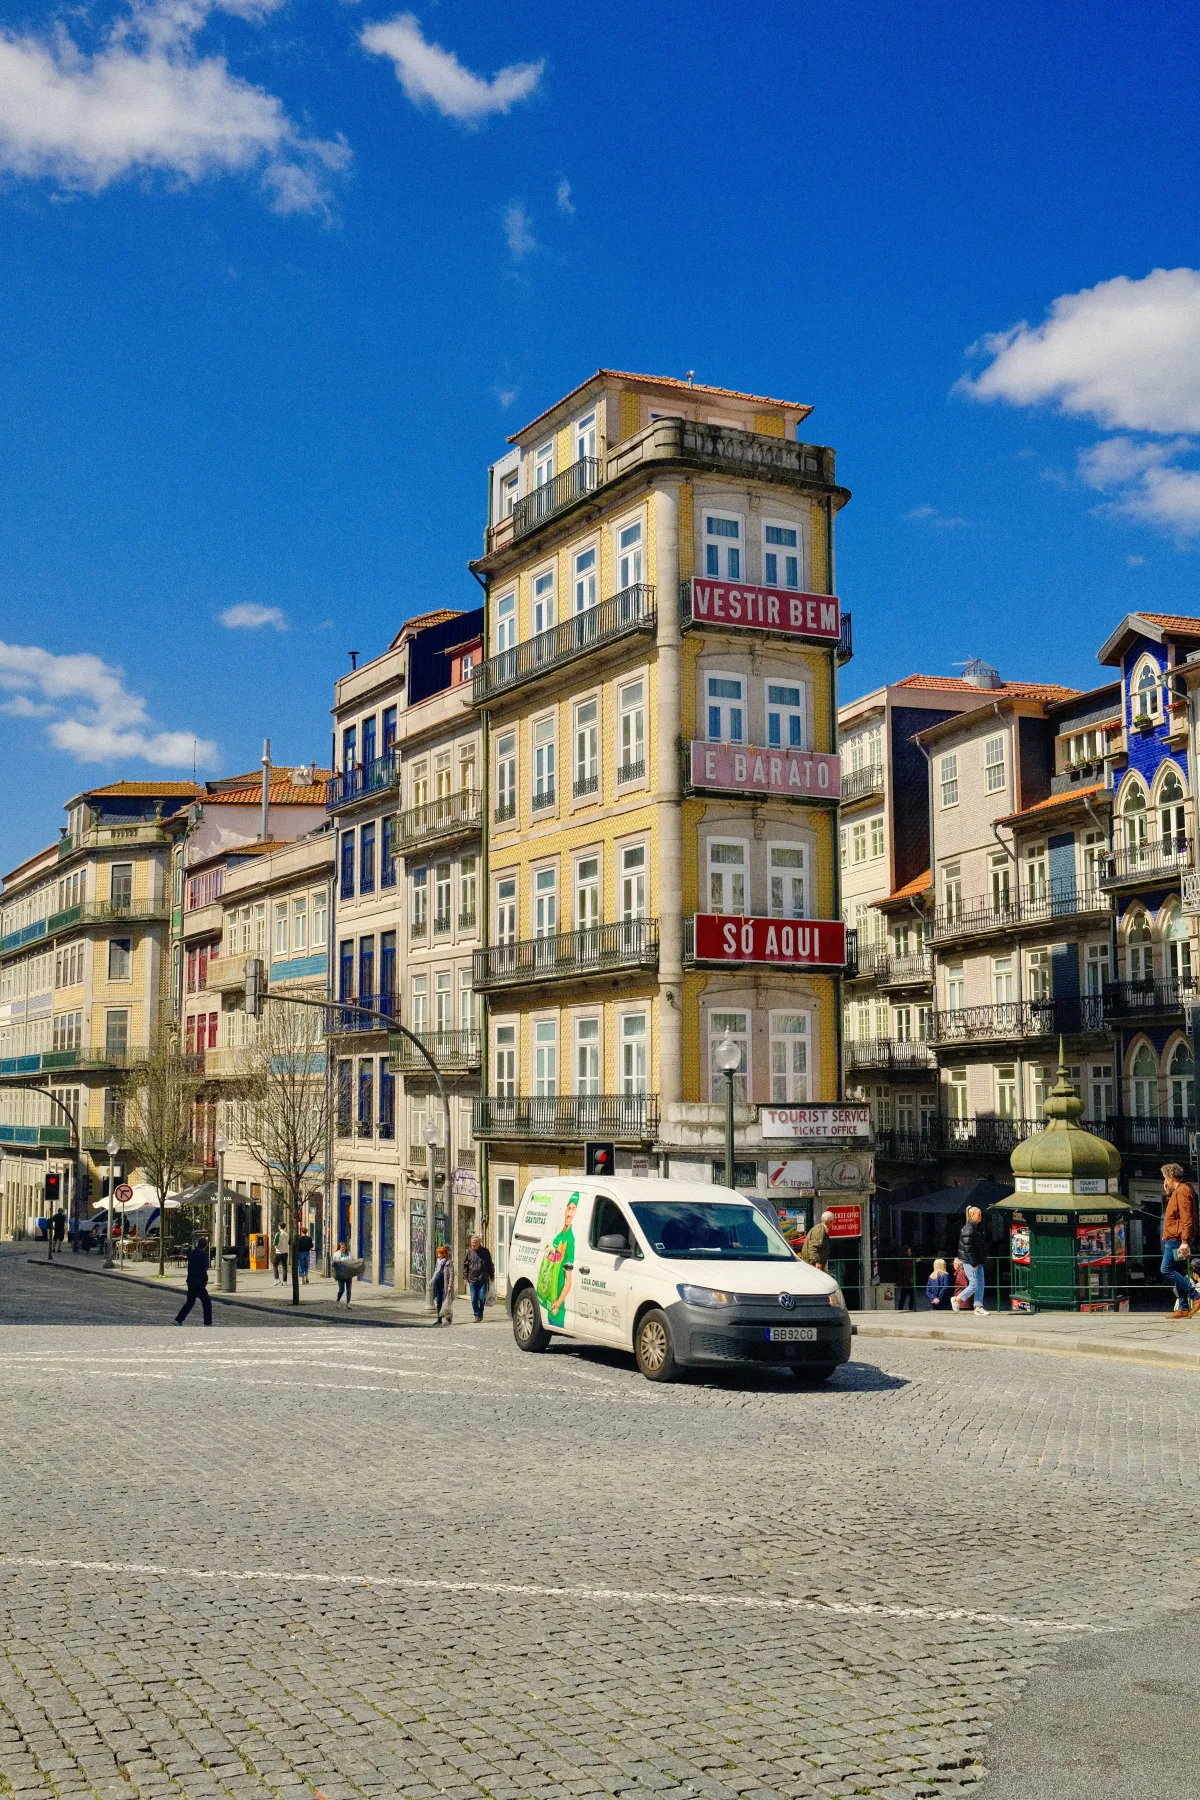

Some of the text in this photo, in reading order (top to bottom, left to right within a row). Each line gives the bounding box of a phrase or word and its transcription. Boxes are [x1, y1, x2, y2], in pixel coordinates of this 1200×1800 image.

[696, 586, 836, 631] VESTIR BEM
[734, 753, 829, 789] BARATO
[723, 919, 820, 957] SÓ AQUI
[768, 1110, 868, 1124] TOURIST SERVICE
[792, 1125, 857, 1135] TICKET OFFICE
[790, 1179, 812, 1187] travel
